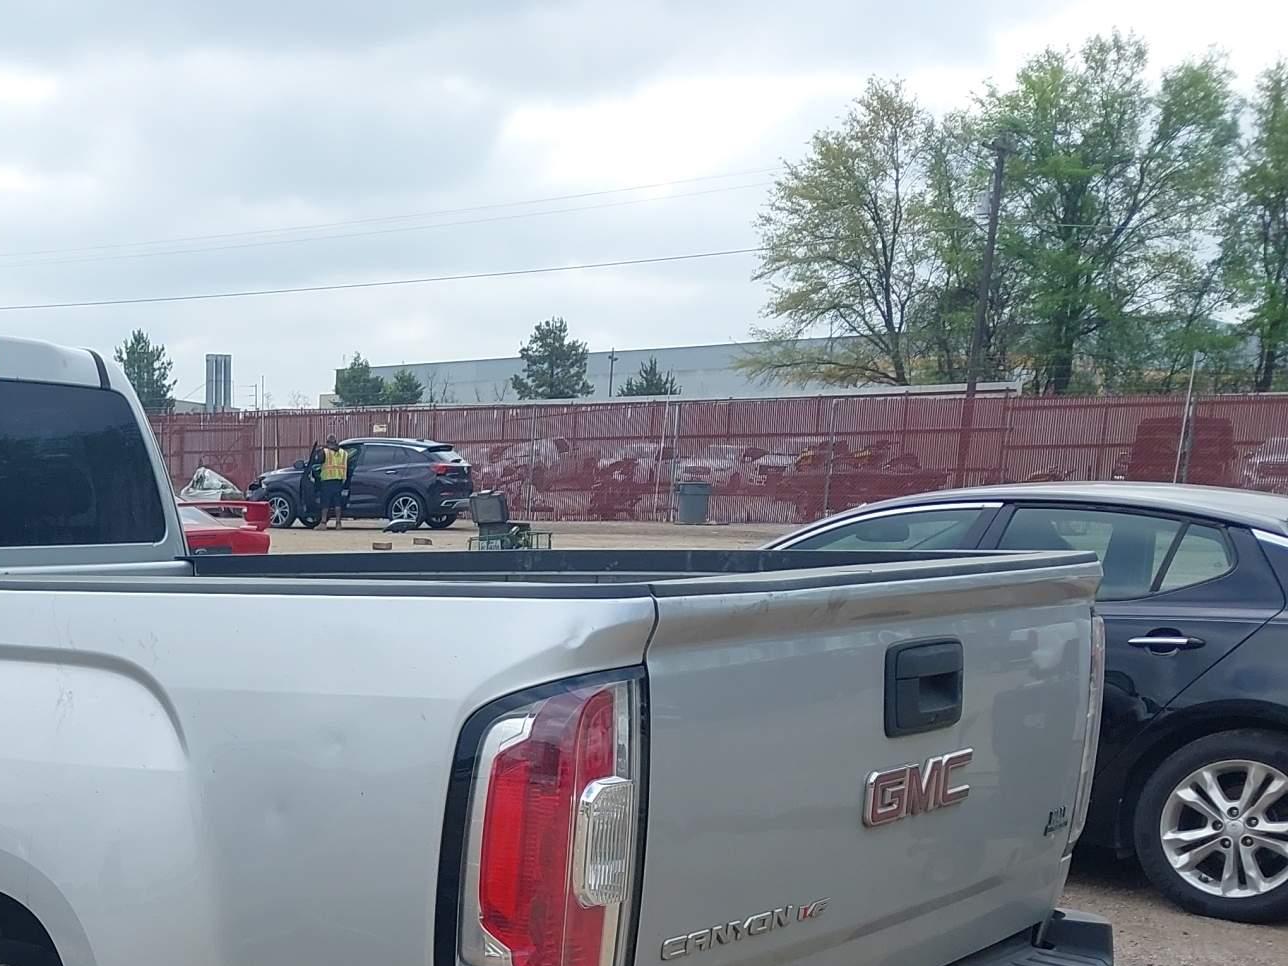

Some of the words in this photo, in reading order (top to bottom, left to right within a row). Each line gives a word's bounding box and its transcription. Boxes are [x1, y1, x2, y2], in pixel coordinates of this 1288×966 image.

[863, 747, 974, 828] GMC
[660, 905, 793, 960] CANYON
[797, 897, 832, 922] V6
